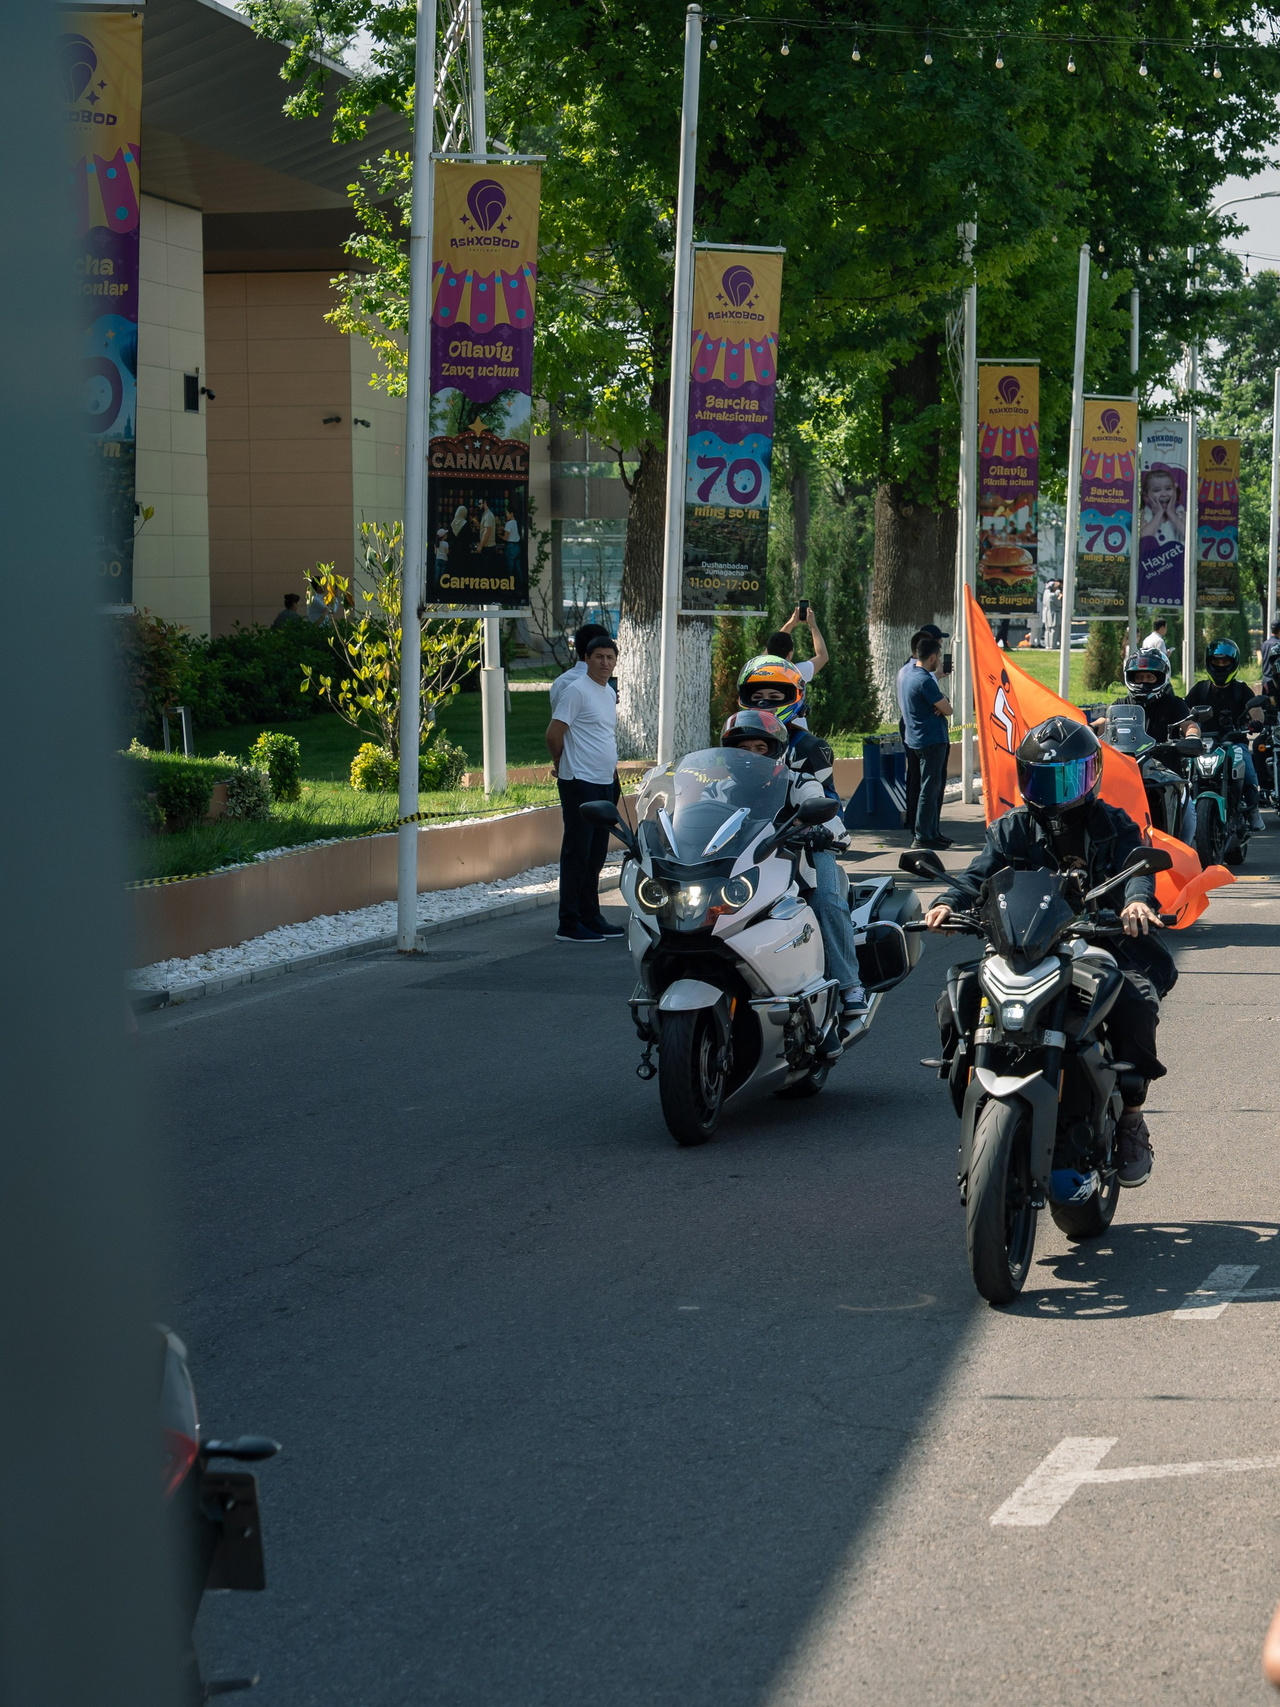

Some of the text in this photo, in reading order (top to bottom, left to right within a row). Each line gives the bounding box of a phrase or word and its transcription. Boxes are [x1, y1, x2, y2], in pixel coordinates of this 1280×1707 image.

[448, 341, 514, 362] Oilaviy
[441, 363, 520, 379] Zavq uchun
[705, 395, 759, 410] Barcha
[695, 410, 768, 423] Attraksionlar
[1147, 435, 1183, 444] ASHXOBOD
[431, 452, 526, 471] CARNAVAL
[989, 465, 1028, 478] Oilaviy
[696, 454, 762, 505] 70
[1090, 487, 1124, 497] Barcha
[694, 506, 726, 520] ming
[1084, 523, 1127, 554] 70
[1201, 536, 1234, 560] 70
[1141, 544, 1183, 571] Hayrat
[701, 561, 749, 571] Dushanbadan
[704, 569, 745, 577] Jumagacha
[439, 573, 515, 590] Carnaval
[1145, 570, 1157, 580] shu
[689, 577, 760, 591] 11:00-17:00
[980, 595, 1035, 606] Tez Burger
[1080, 597, 1125, 606] 11:00-17:00
